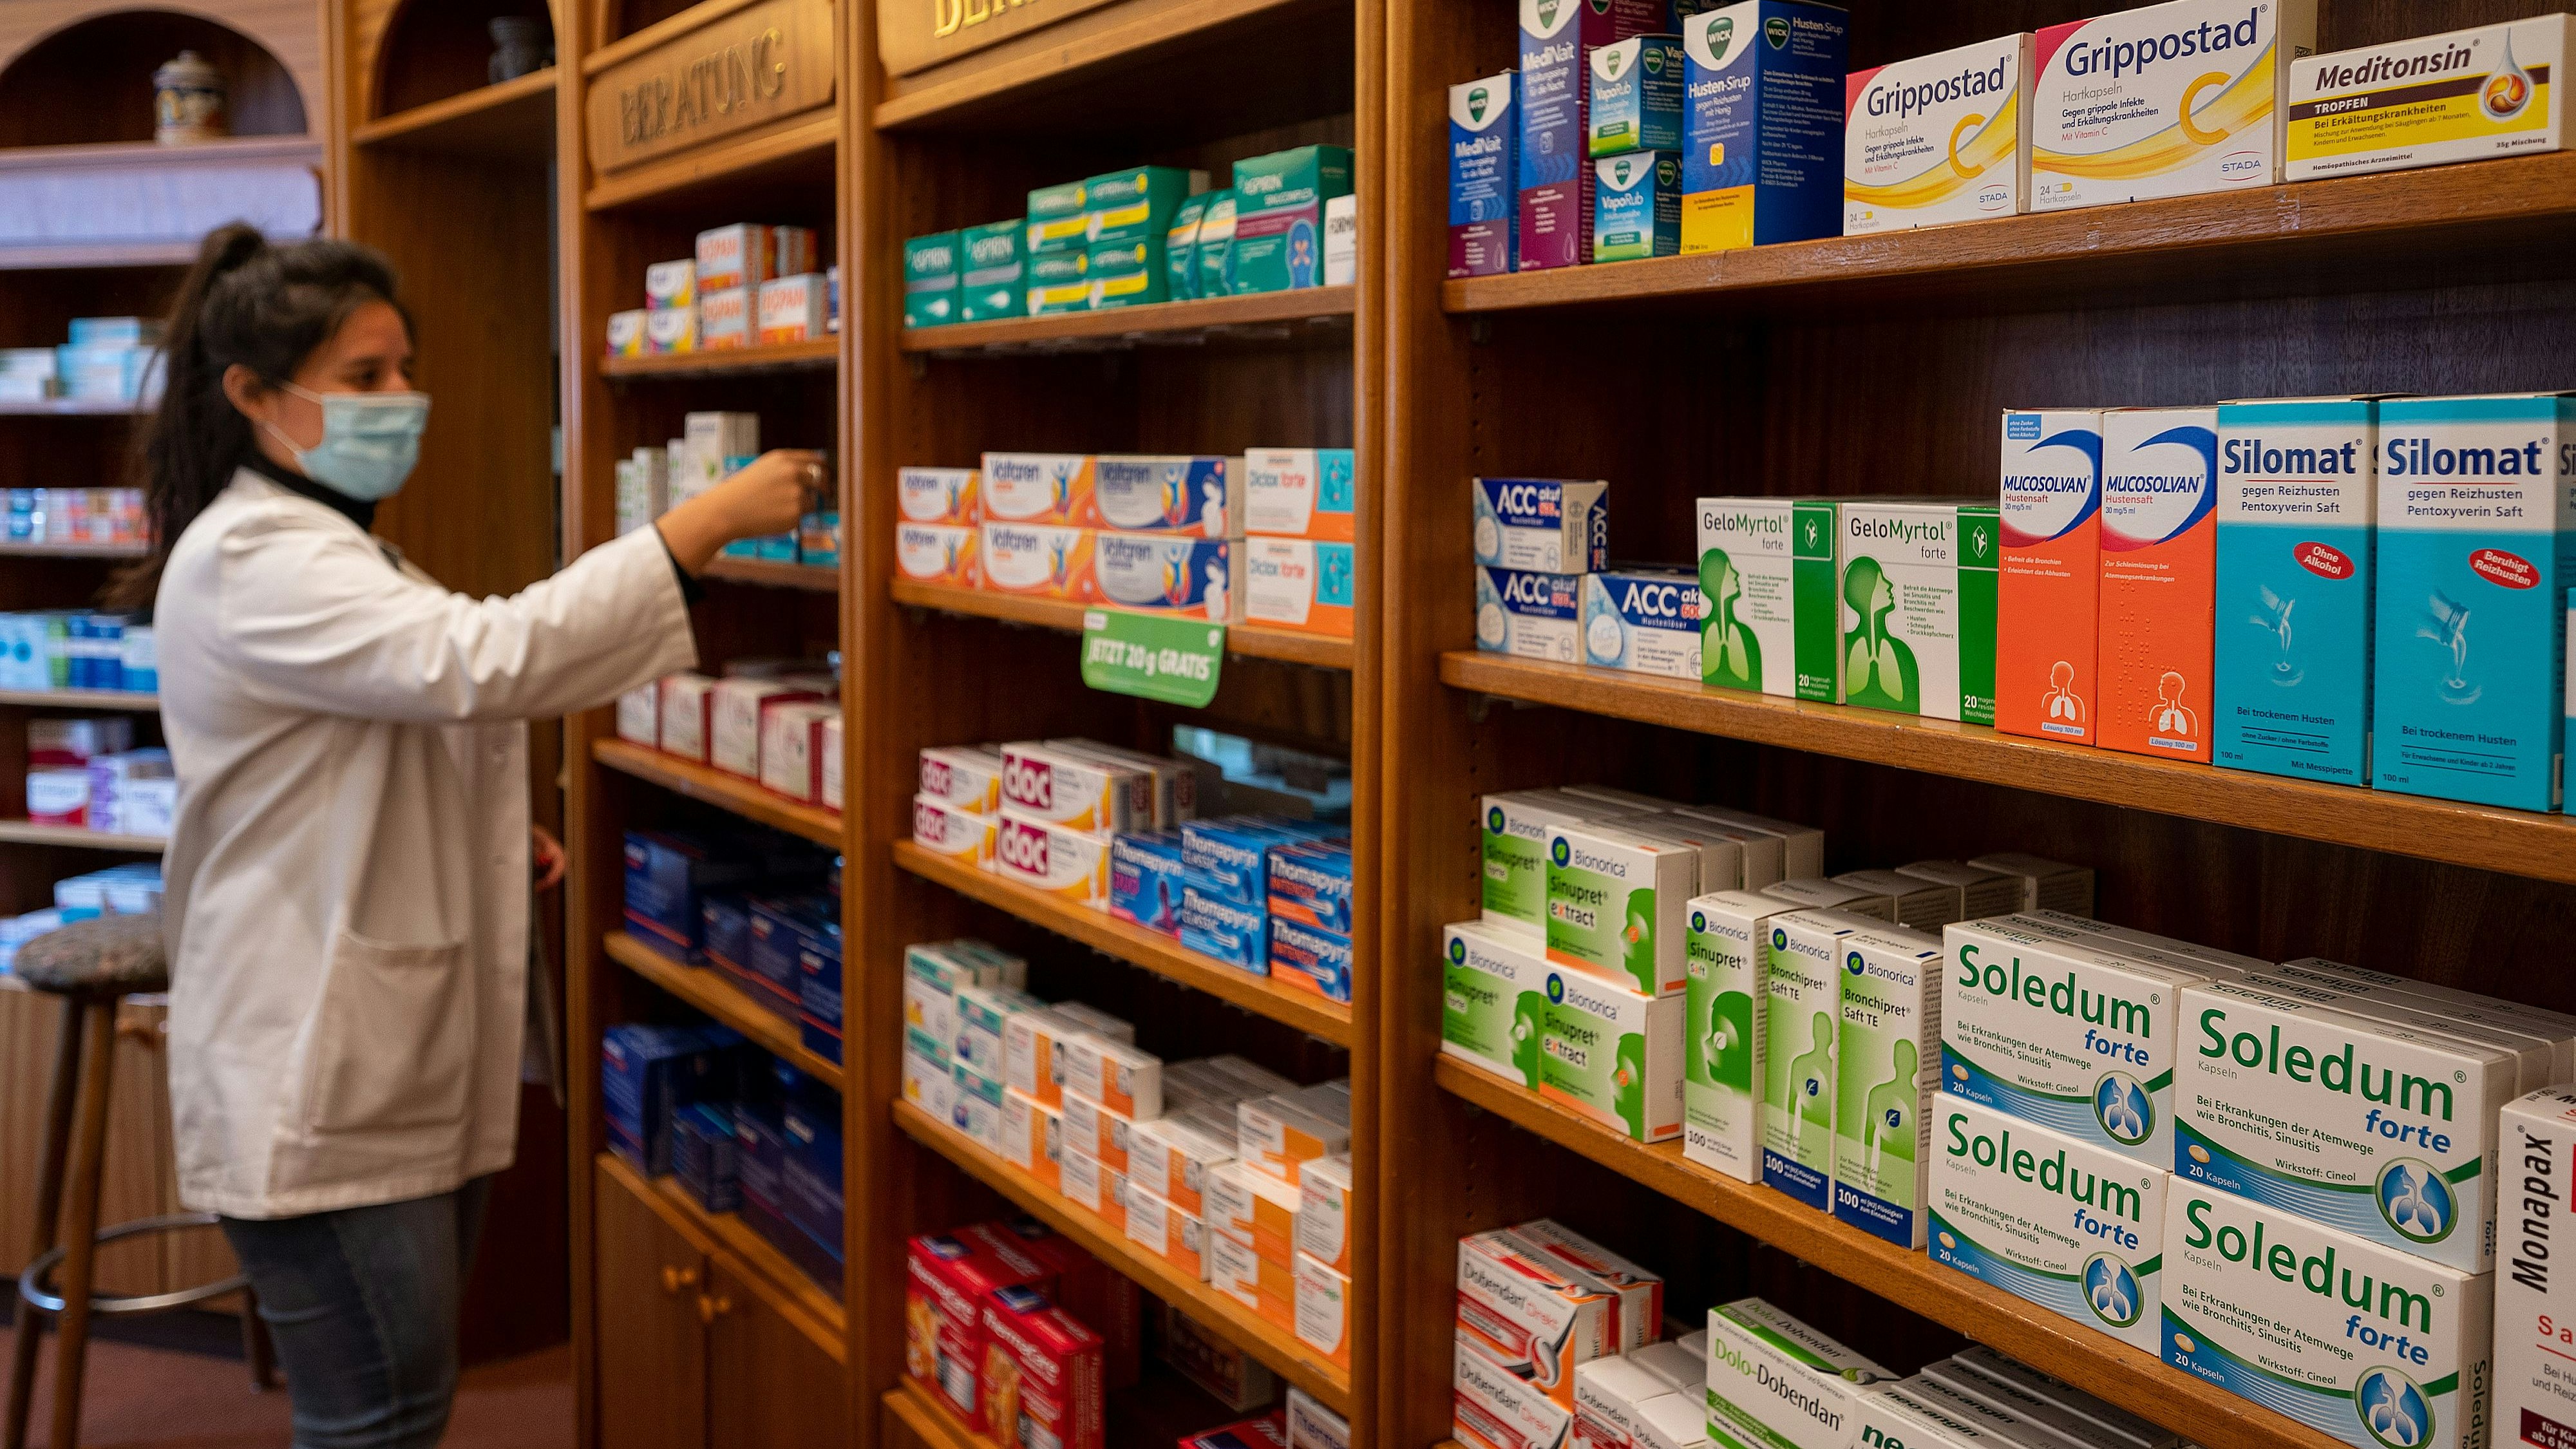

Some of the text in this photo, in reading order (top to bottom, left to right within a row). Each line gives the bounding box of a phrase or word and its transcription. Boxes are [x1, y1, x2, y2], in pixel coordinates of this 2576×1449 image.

[1709, 29, 1731, 44] WICK
[1688, 76, 1750, 99] Husten-Sirup
[2063, 81, 2122, 102] Hartkapseln
[2062, 97, 2145, 119] Gegen grippale Infekte
[2315, 97, 2369, 114] TROPFEN
[2062, 107, 2159, 129] und Erkältungskrankheiten
[2315, 103, 2447, 129] Bei Erkältungskrankheiten
[1865, 121, 1908, 140] Hartkapseln
[2061, 133, 2072, 142] Mit
[2074, 129, 2100, 140] Vitamin
[2512, 137, 2547, 147] Mischung
[2222, 159, 2262, 172] STADA
[2313, 153, 2413, 172] Homöopathisches Arzneimittel
[1979, 193, 2008, 203] STADA
[2040, 185, 2050, 195] 24
[2040, 192, 2081, 205] Hartkapseln
[1497, 484, 1537, 515] ACC
[2005, 494, 2049, 502] Hustensaft
[2106, 495, 2153, 504] Hustensaft
[2242, 486, 2340, 497] gegen Reizhusten
[2408, 488, 2523, 500] gegen Reizhusten
[2114, 507, 2127, 516] mg/5
[2242, 501, 2340, 513] Pentoxyverin Saft
[2408, 505, 2523, 518] Pentoxyverin Saft
[1762, 538, 1783, 550] forte
[1921, 546, 1946, 560] forte
[2035, 557, 2061, 565] Bronchien
[2313, 546, 2338, 562] Ohne
[2483, 551, 2529, 573] Beruhigt
[2045, 569, 2070, 578] Abhusten
[2116, 562, 2159, 570] Schleimlösung
[2304, 554, 2342, 575] Alkohol
[2475, 560, 2532, 587] Reizhusten
[2105, 572, 2175, 583] Atemwegserkrankungen
[1622, 582, 1677, 618] ACC
[1087, 638, 1124, 665] JETZT
[1159, 648, 1210, 681] GRATIS
[1799, 674, 1809, 687] 20
[1964, 695, 1977, 708] 20
[2237, 706, 2335, 725] Bei trockenem Husten
[2043, 724, 2063, 733] Lösung
[2402, 726, 2517, 746] Bei trockenem Husten
[2151, 739, 2173, 747] Lösung
[2221, 751, 2243, 761] 100 ml
[2291, 761, 2353, 776] Mit Messpipette
[1003, 754, 1051, 808] doc
[1001, 817, 1048, 873] doc
[1575, 850, 1625, 877] Bionorica
[1551, 902, 1595, 926] extract
[1709, 921, 1748, 941] Bionorica
[1790, 939, 1830, 961] Bionorica
[1690, 963, 1705, 976] Saft
[1868, 963, 1915, 986] Bionorica
[1771, 981, 1799, 1000] Saft TE
[1958, 990, 1988, 1007] Kapseln
[1844, 1007, 1879, 1027] Saft TE
[1545, 1038, 1587, 1066] extract
[1958, 1021, 2091, 1070] Bei Erkrankungen der Atemwege
[1958, 1034, 2052, 1069] wie Bronchitis, Sinusitis
[2085, 1029, 2150, 1066] forte
[2199, 1061, 2238, 1080] Kapseln
[1953, 1081, 1992, 1104] 20 Kapseln
[2018, 1074, 2079, 1094] Wirkstoff: Cineol
[2365, 1109, 2452, 1154] forte
[1766, 1155, 1783, 1175] 100
[1838, 1189, 1859, 1209] 100
[2074, 1209, 2139, 1249] forte
[2345, 1315, 2429, 1366] forte
[2175, 1352, 2225, 1382] 20 Kapseln
[2532, 1432, 2546, 1443] ab
[2542, 1421, 2557, 1435] für
